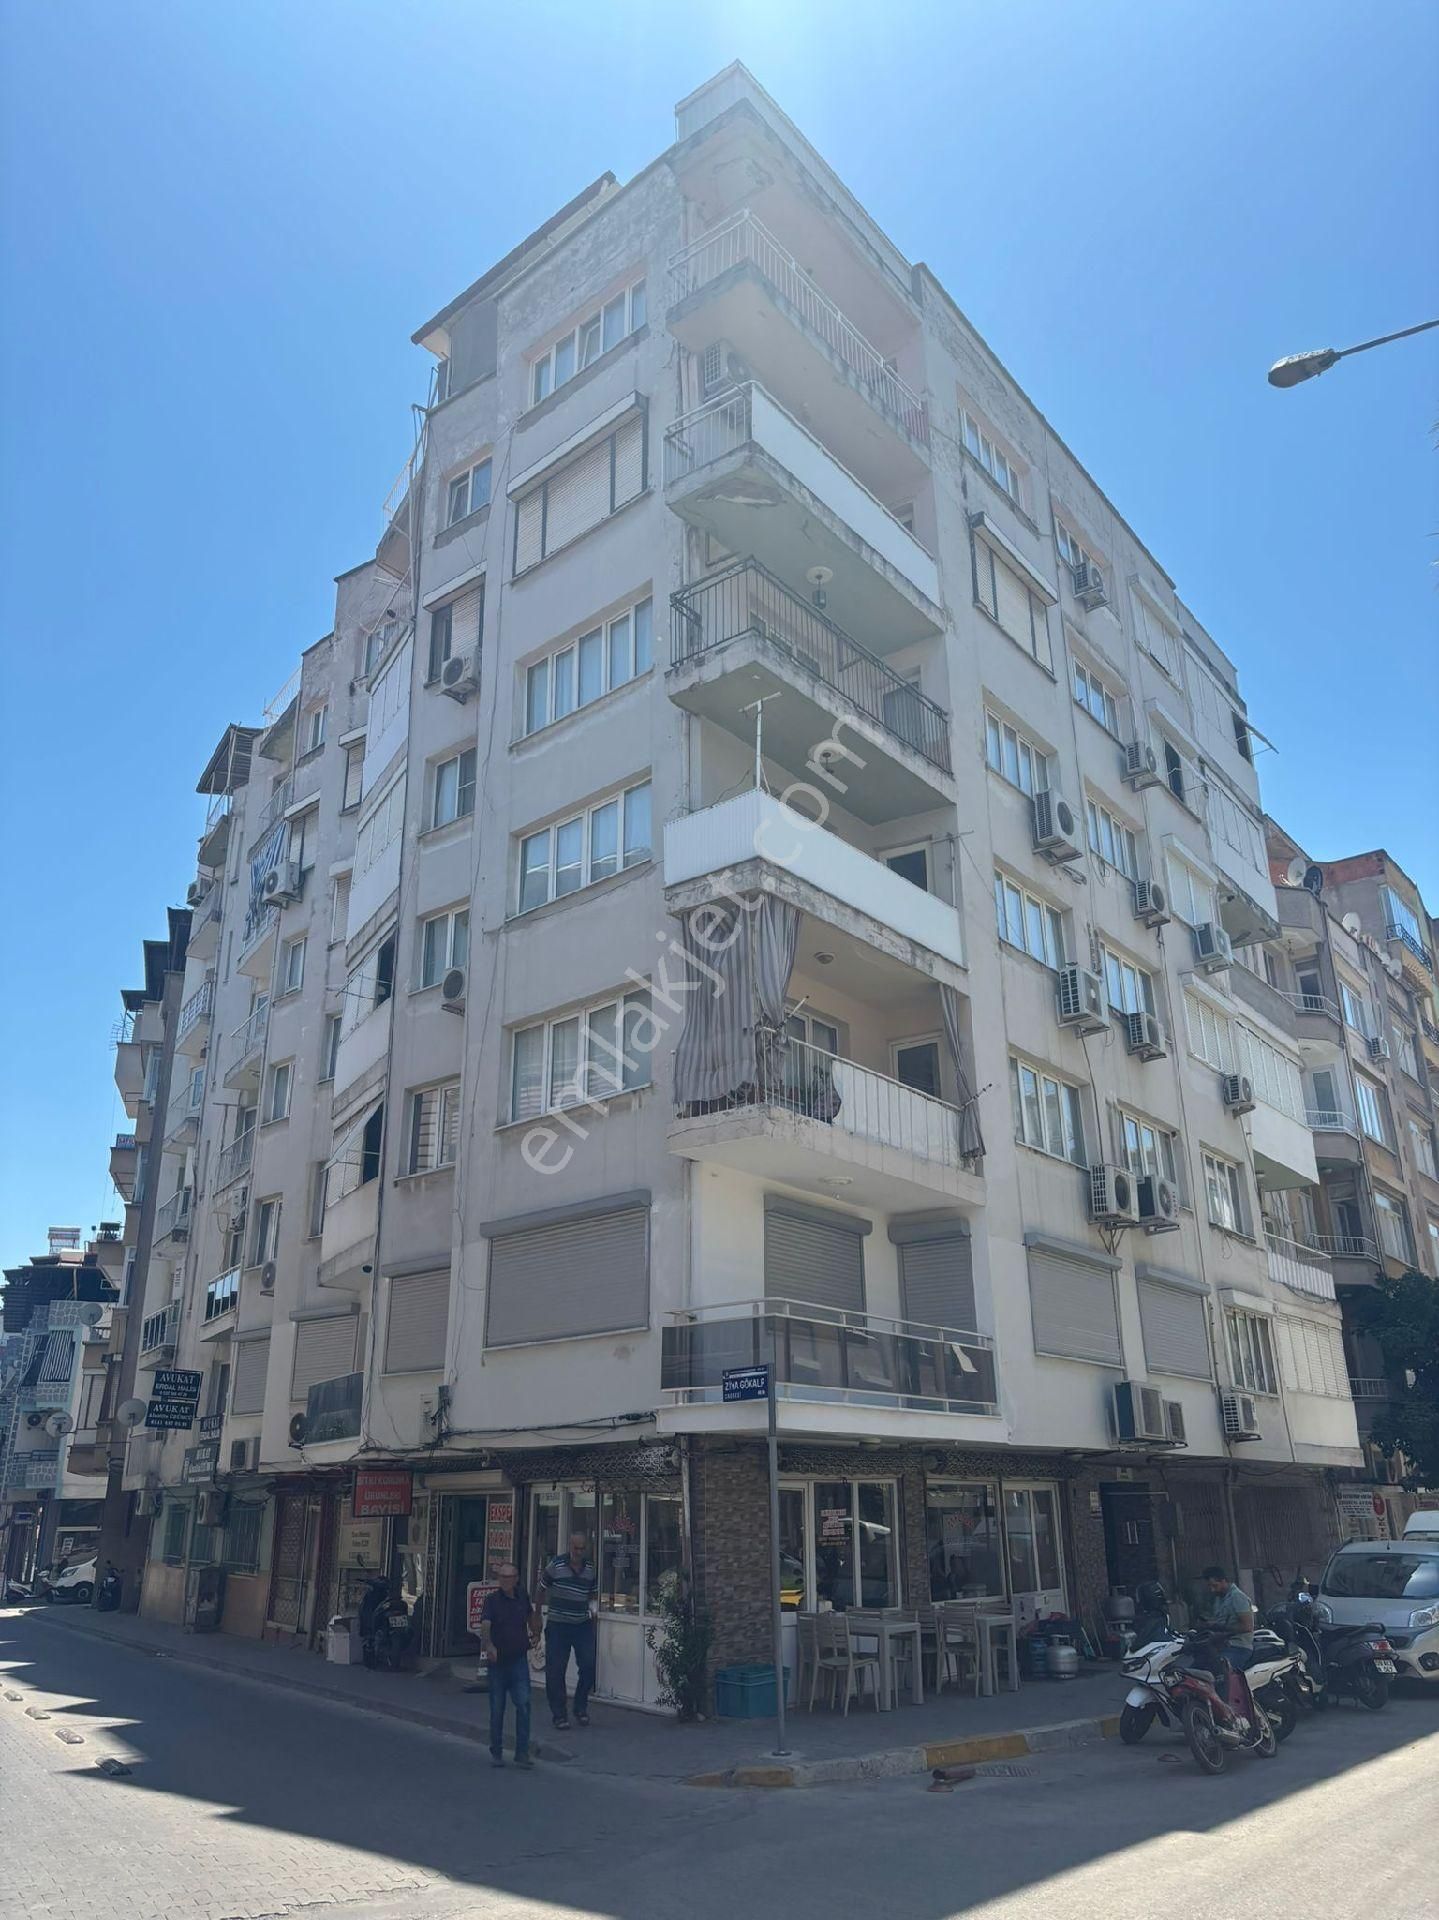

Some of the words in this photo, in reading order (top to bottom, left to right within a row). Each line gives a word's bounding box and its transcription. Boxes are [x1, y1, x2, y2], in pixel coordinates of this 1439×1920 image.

[159, 1373, 196, 1384] AVUKAT
[740, 1377, 765, 1389] GÖKALP
[153, 1404, 190, 1414] AVUKAT
[360, 1501, 405, 1516] BAYİSİ
